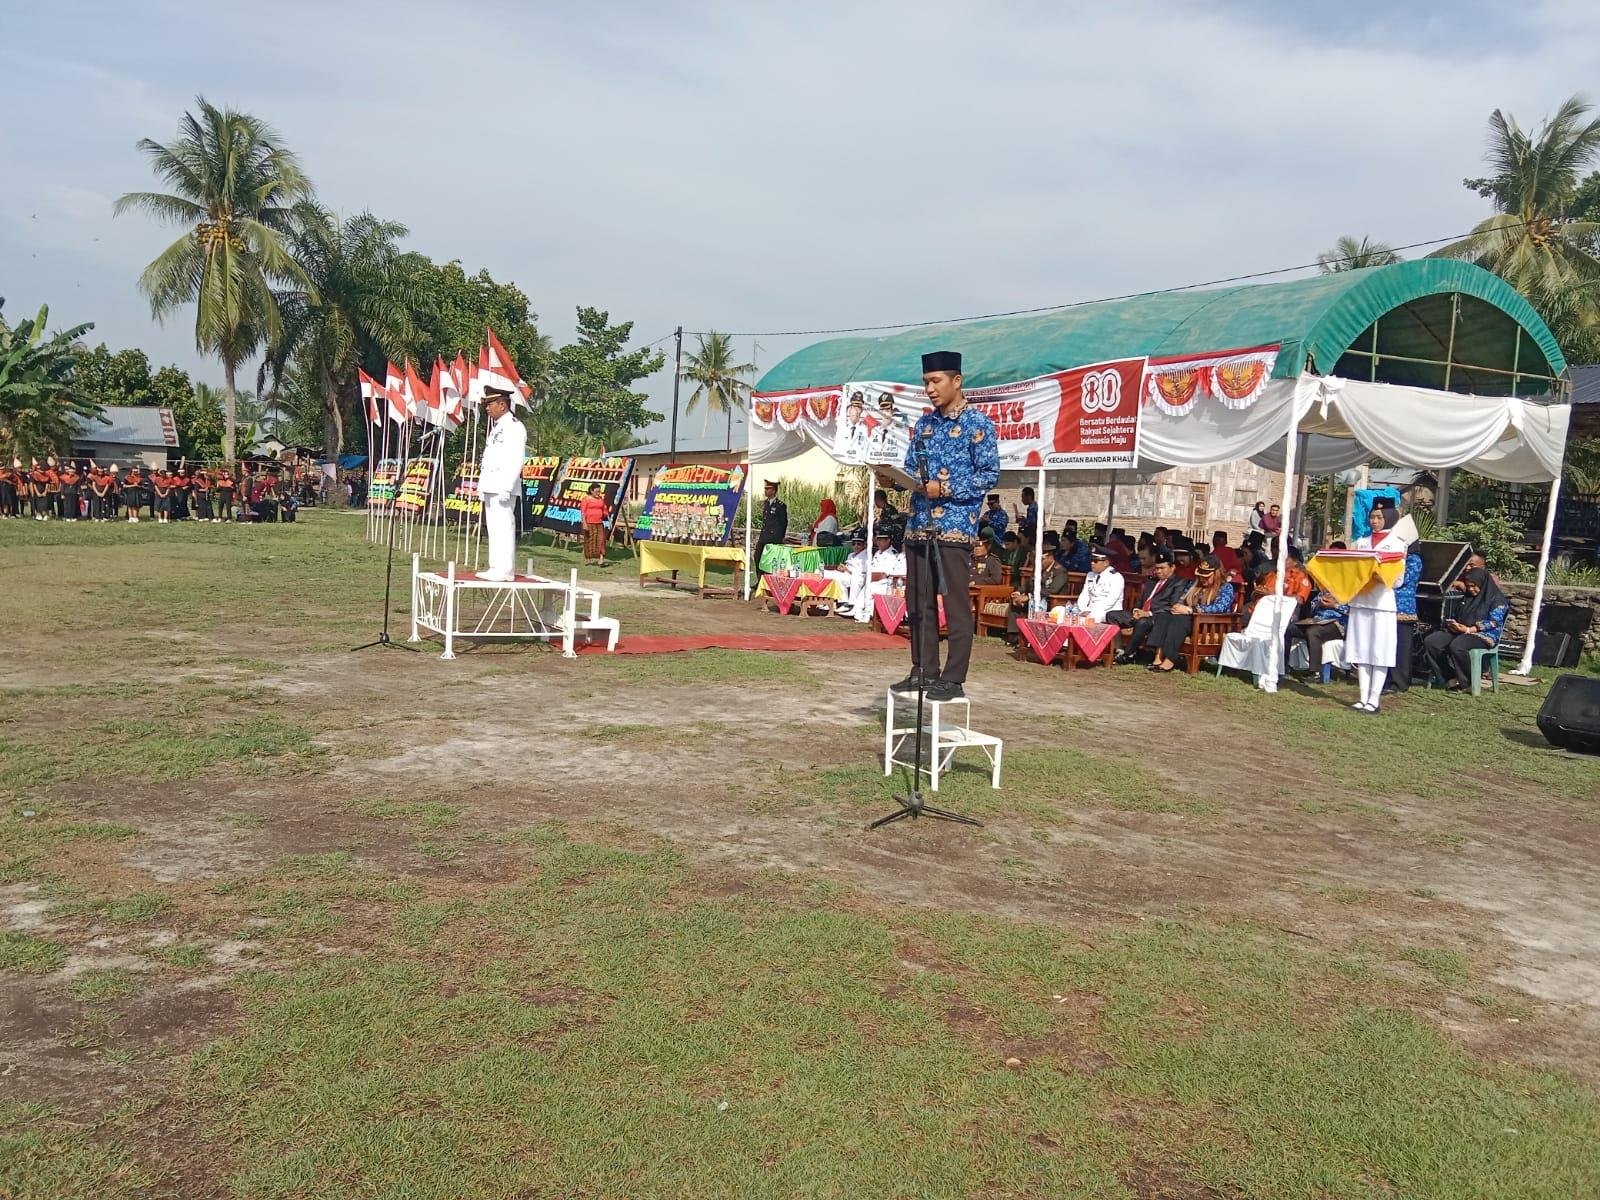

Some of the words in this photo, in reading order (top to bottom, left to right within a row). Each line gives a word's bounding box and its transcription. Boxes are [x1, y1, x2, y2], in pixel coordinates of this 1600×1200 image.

[1081, 368, 1122, 413] 80
[1079, 418, 1105, 426] Bersatu
[1080, 427, 1102, 436] Rakyat
[1102, 425, 1134, 436] Sejahtera
[1080, 436, 1110, 445] Indonesia
[1111, 435, 1127, 446] Maju
[1048, 456, 1084, 464] KECAMATAN
